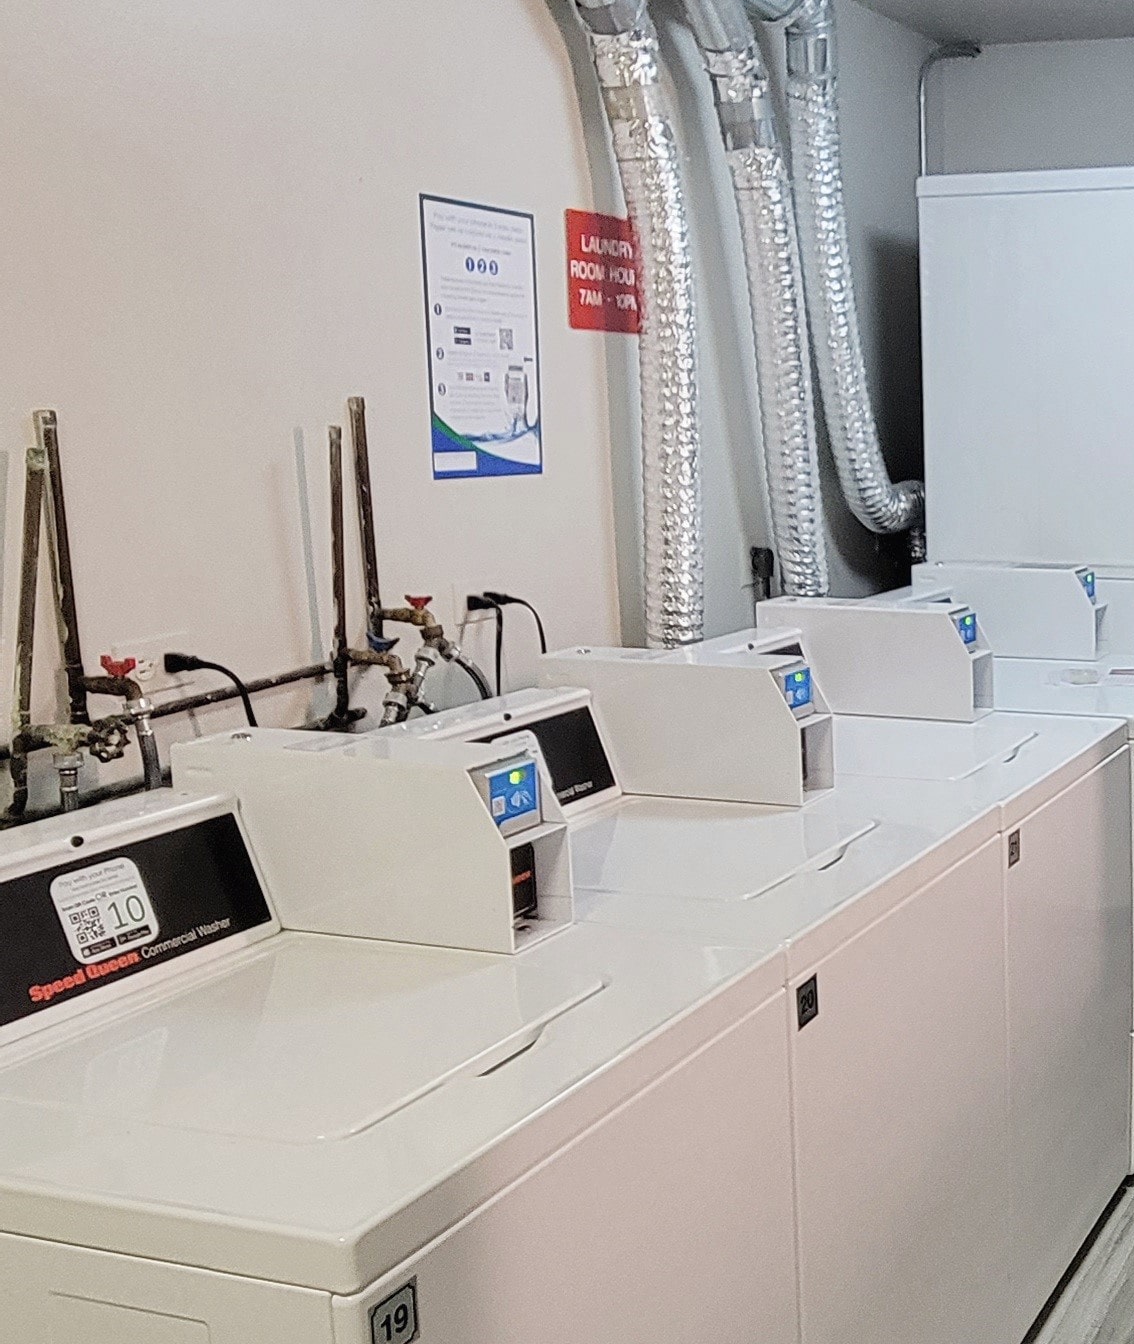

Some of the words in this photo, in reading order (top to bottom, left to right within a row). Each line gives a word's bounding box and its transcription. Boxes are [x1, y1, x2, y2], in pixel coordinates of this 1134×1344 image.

[570, 260, 604, 281] ROOM
[609, 266, 636, 286] HOU
[579, 288, 603, 306] 7AM
[107, 895, 145, 930] 10
[28, 968, 86, 1002] Speed
[86, 951, 139, 979] Queen
[140, 929, 197, 959] Commercial
[197, 917, 231, 939] Washer
[800, 989, 814, 1015] 20
[380, 1303, 408, 1341] 19
